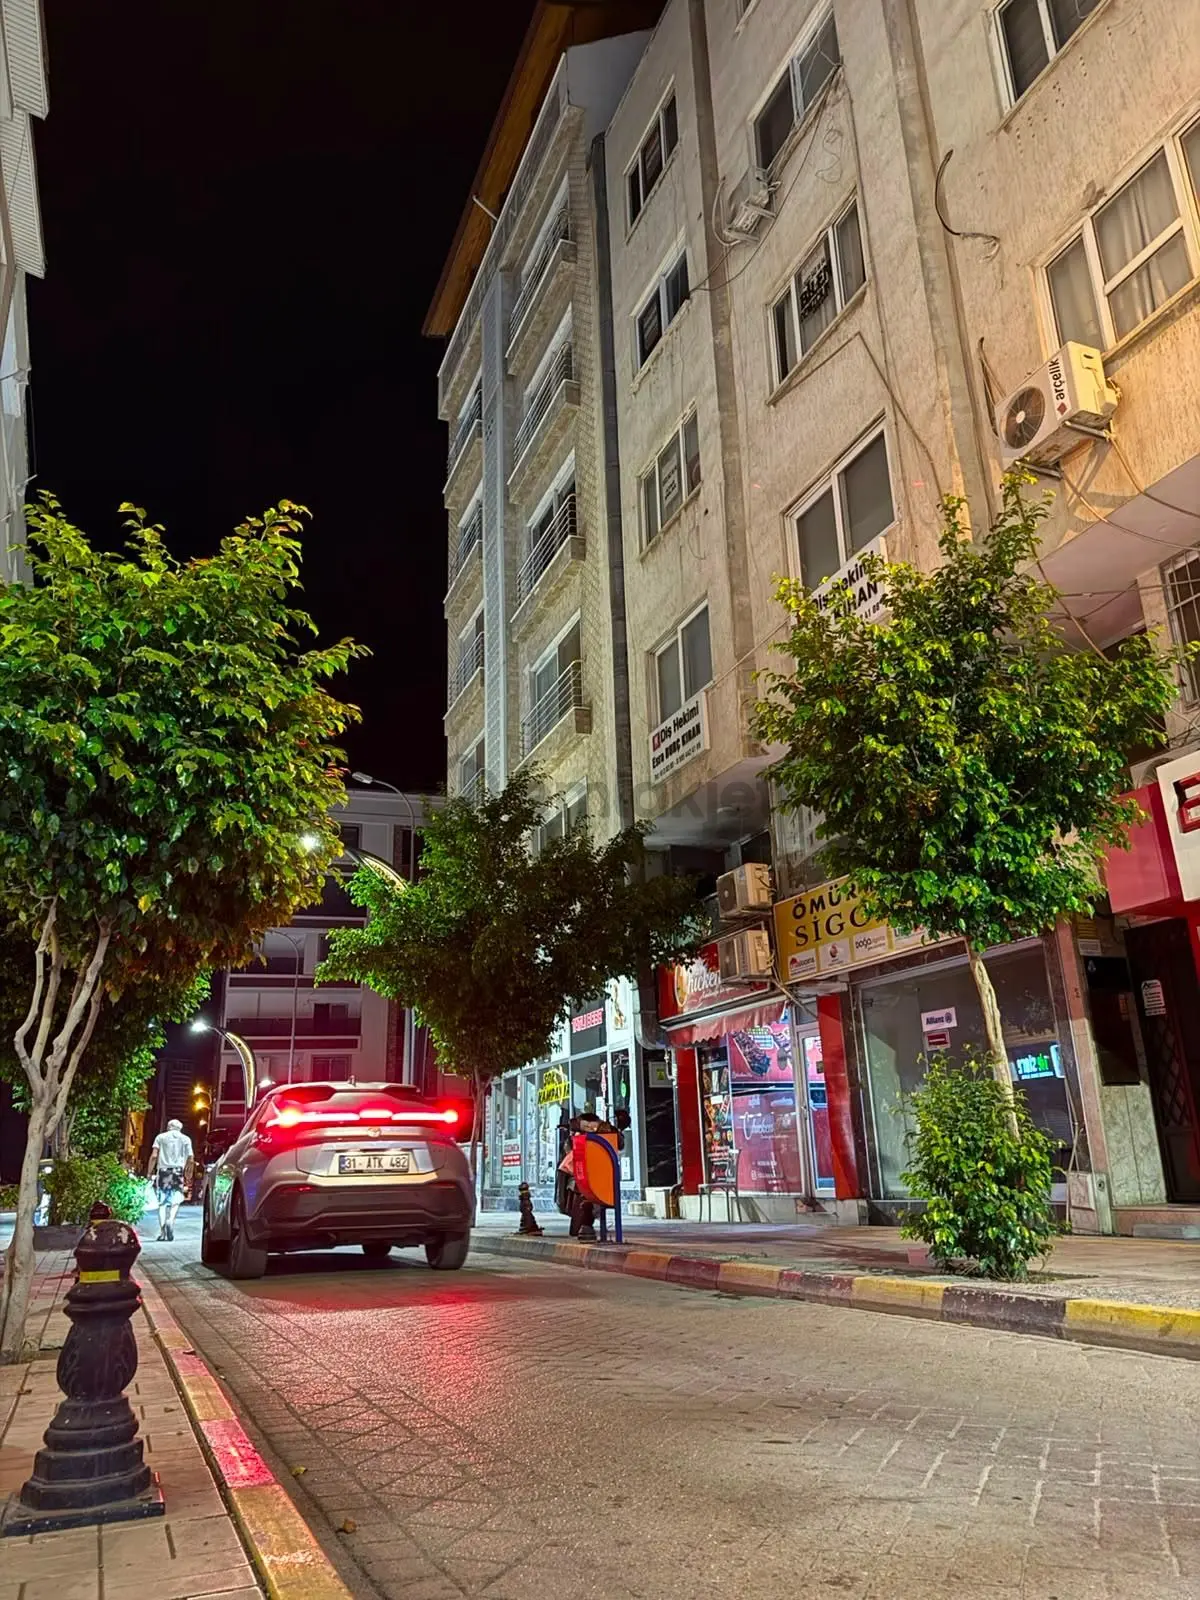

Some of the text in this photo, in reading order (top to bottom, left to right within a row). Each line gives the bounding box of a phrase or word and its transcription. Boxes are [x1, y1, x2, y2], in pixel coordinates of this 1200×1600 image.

[1048, 358, 1065, 401] arçelik
[660, 700, 700, 744] Diş Hekimi
[792, 883, 857, 920] ÖMÜR
[346, 1158, 356, 1168] 31
[389, 1157, 408, 1167] 482
